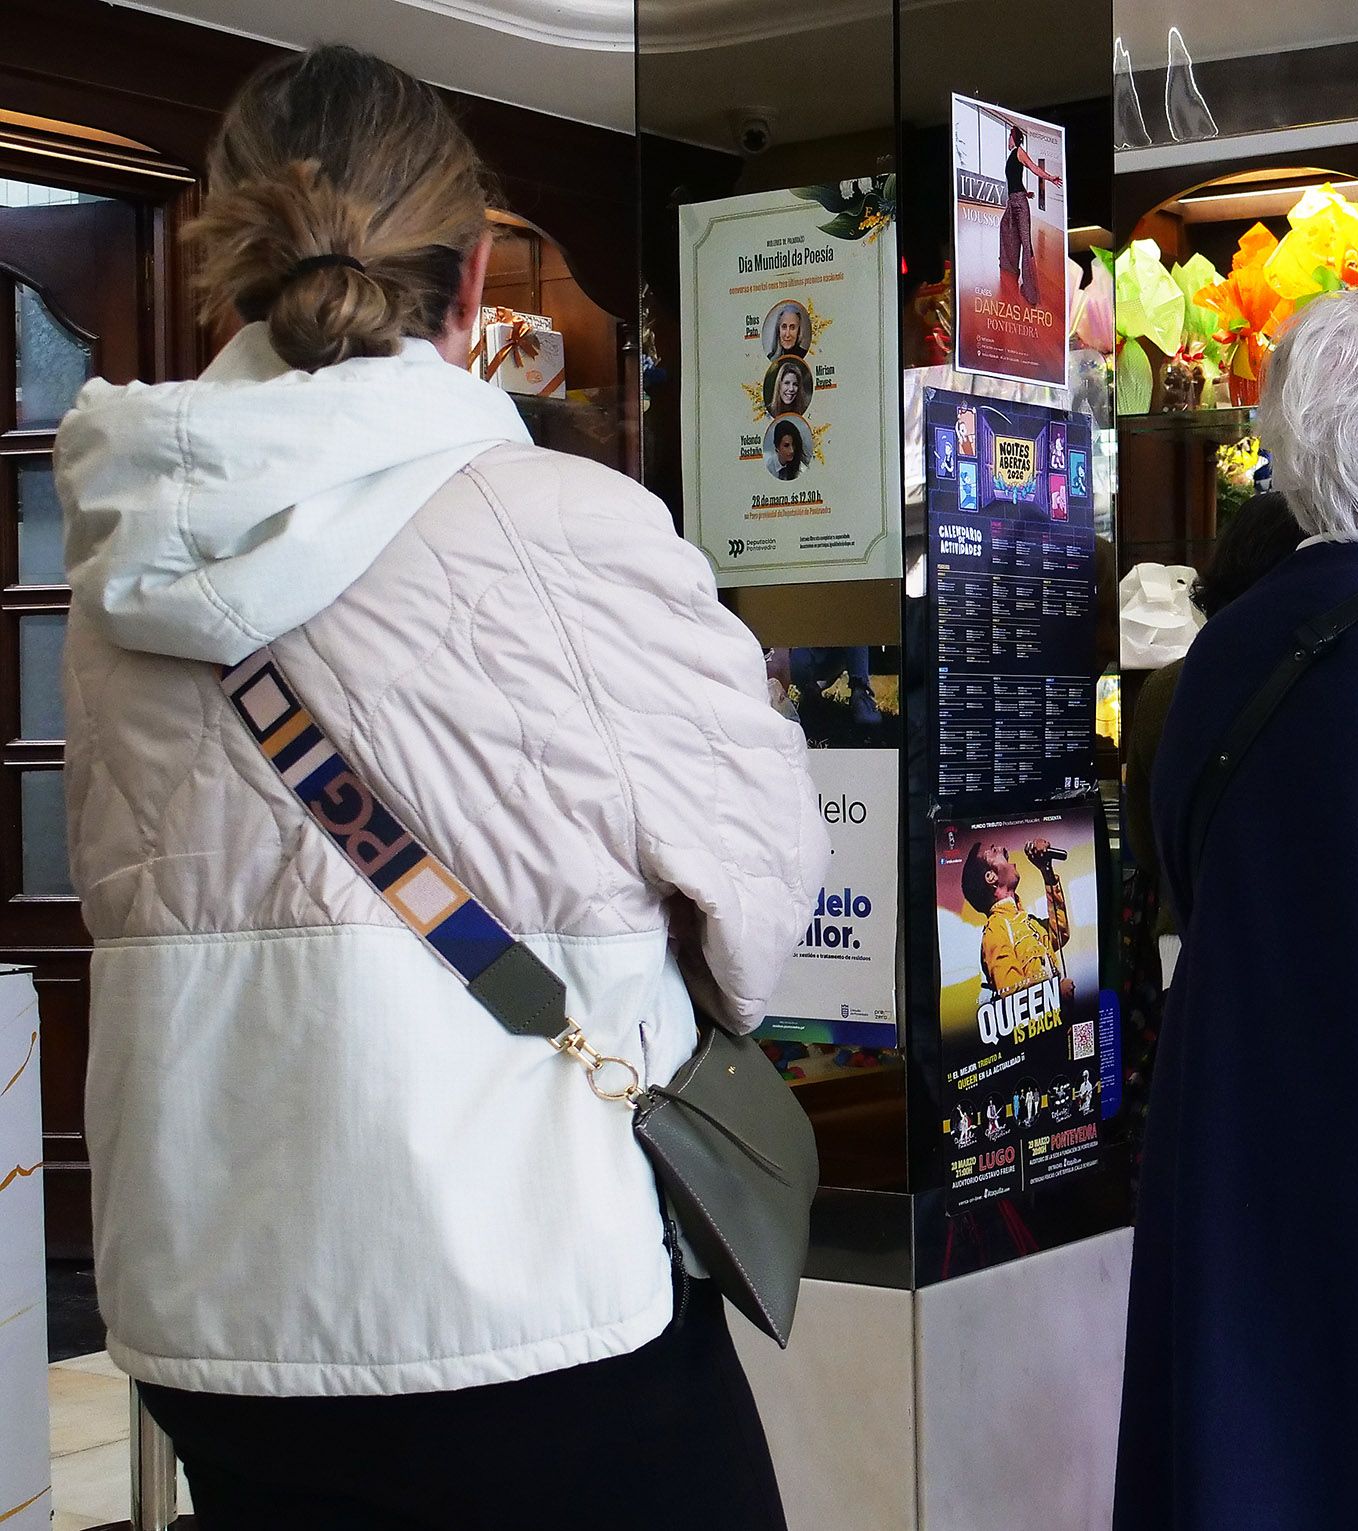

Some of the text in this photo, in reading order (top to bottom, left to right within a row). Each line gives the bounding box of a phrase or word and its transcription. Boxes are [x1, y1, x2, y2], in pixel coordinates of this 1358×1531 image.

[961, 175, 1004, 205] ITZZY
[738, 245, 834, 274] Día Mundial da Poesía
[974, 297, 1052, 327] DANZAS AFRO
[988, 318, 1039, 338] PONTEVEDRA
[816, 365, 834, 376] Miriam
[740, 434, 761, 446] Yolanda
[1000, 442, 1030, 458] NOITES
[1000, 456, 1030, 472] ABERTAS
[1007, 469, 1024, 480] 2026
[752, 496, 760, 507] 28
[761, 494, 768, 506] de
[799, 490, 816, 504] 12.30
[938, 525, 982, 542] CALENDARIO
[940, 540, 982, 556] ACTIVIDADES
[976, 976, 1061, 1046] QUEEN
[1014, 1008, 1062, 1044] IS BACK
[953, 1072, 959, 1080] EL
[960, 1064, 977, 1076] MEJOR
[978, 1056, 998, 1068] TRIBUTO
[958, 1059, 1020, 1090] QUEEN EN LA ACTUALIDAD
[1051, 1122, 1098, 1151] PONTEVEDRA
[978, 1146, 1016, 1172] LUGO
[952, 1165, 1016, 1188] AUDITORIO GUSTAVO FREIRE
